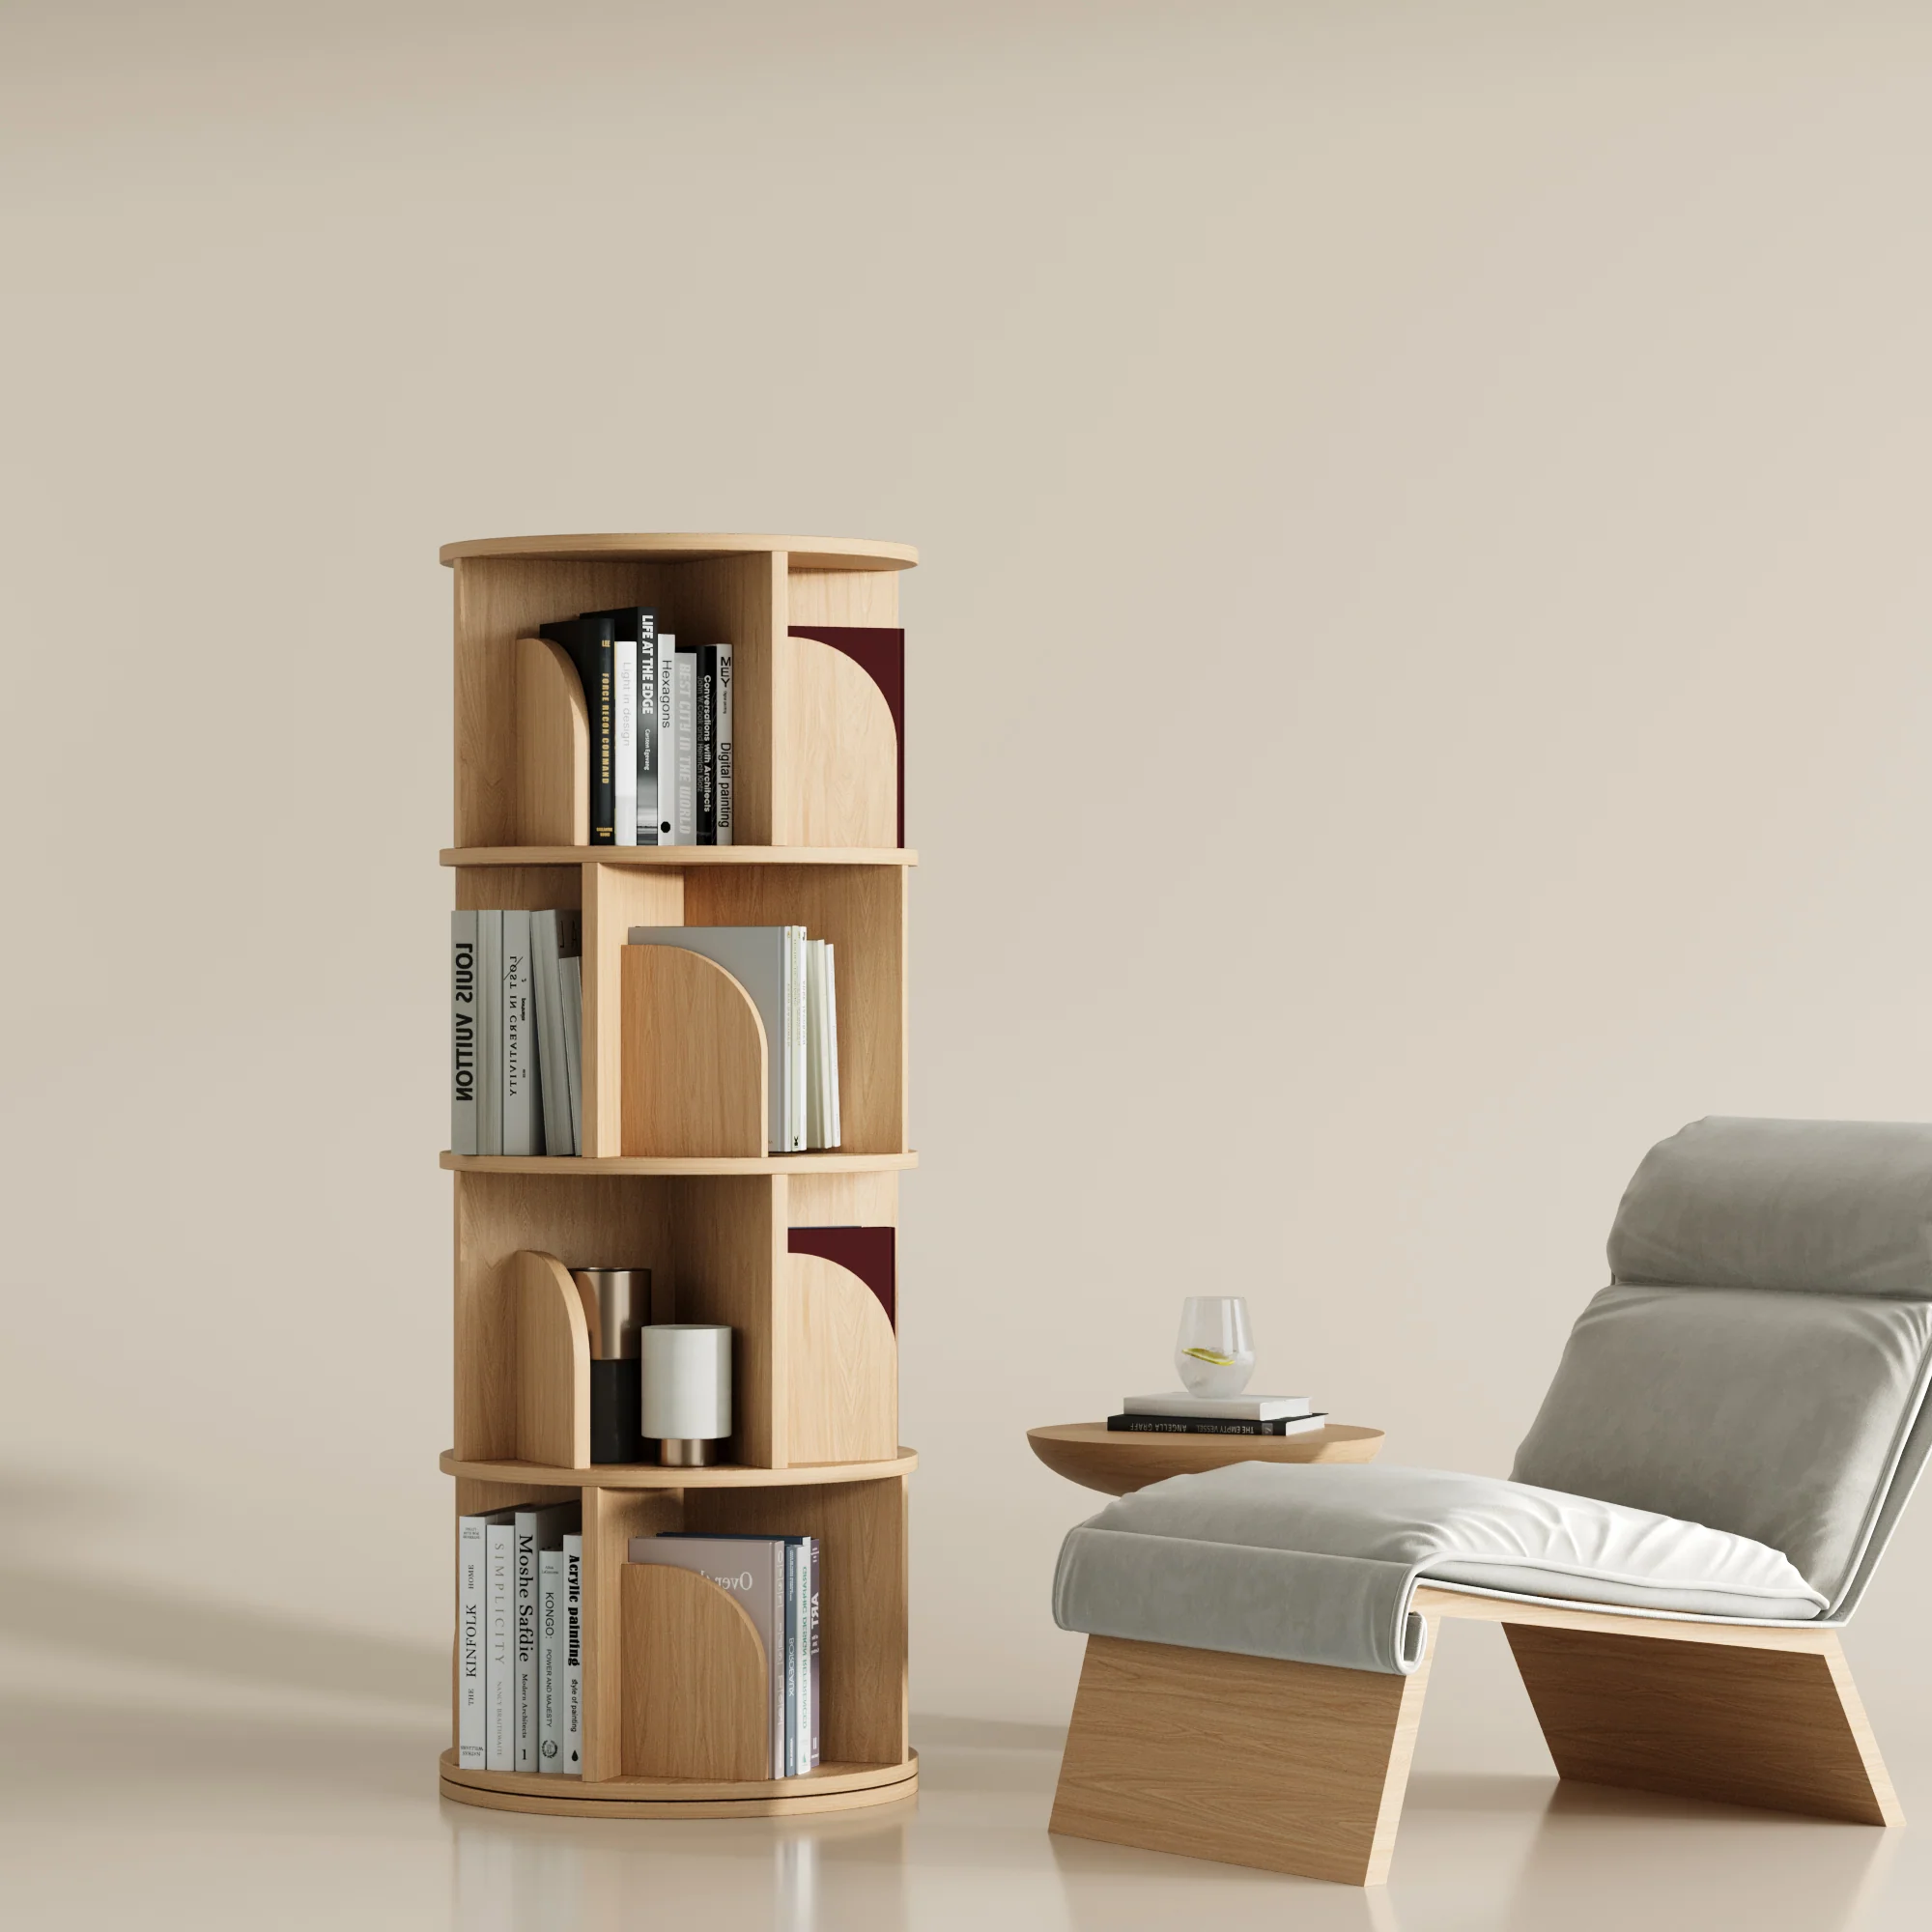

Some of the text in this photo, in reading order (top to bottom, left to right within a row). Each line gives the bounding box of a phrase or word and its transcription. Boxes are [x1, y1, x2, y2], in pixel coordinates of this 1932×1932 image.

[642, 614, 654, 715] LIFE AT THE EDGE
[660, 660, 672, 728] Hexagons
[679, 663, 692, 697] BEST
[621, 662, 632, 747] Light in design
[679, 700, 692, 732] CITY
[679, 755, 692, 782] THE
[703, 674, 712, 812] Conversations with Architects
[679, 786, 692, 835] WORLD
[718, 742, 731, 828] Digital painting
[1130, 1423, 1187, 1433] ANGELLA GRAFF
[1197, 1424, 1255, 1435] THE EMPTY VESSEL
[495, 1543, 505, 1665] SIMPLICITY
[519, 1534, 534, 1662] Moshe Safdie
[545, 1592, 554, 1639] KONGO:
[567, 1554, 581, 1666] Acrylic painting
[466, 1604, 477, 1679] KINFOLK
[570, 1705, 579, 1732] painting
